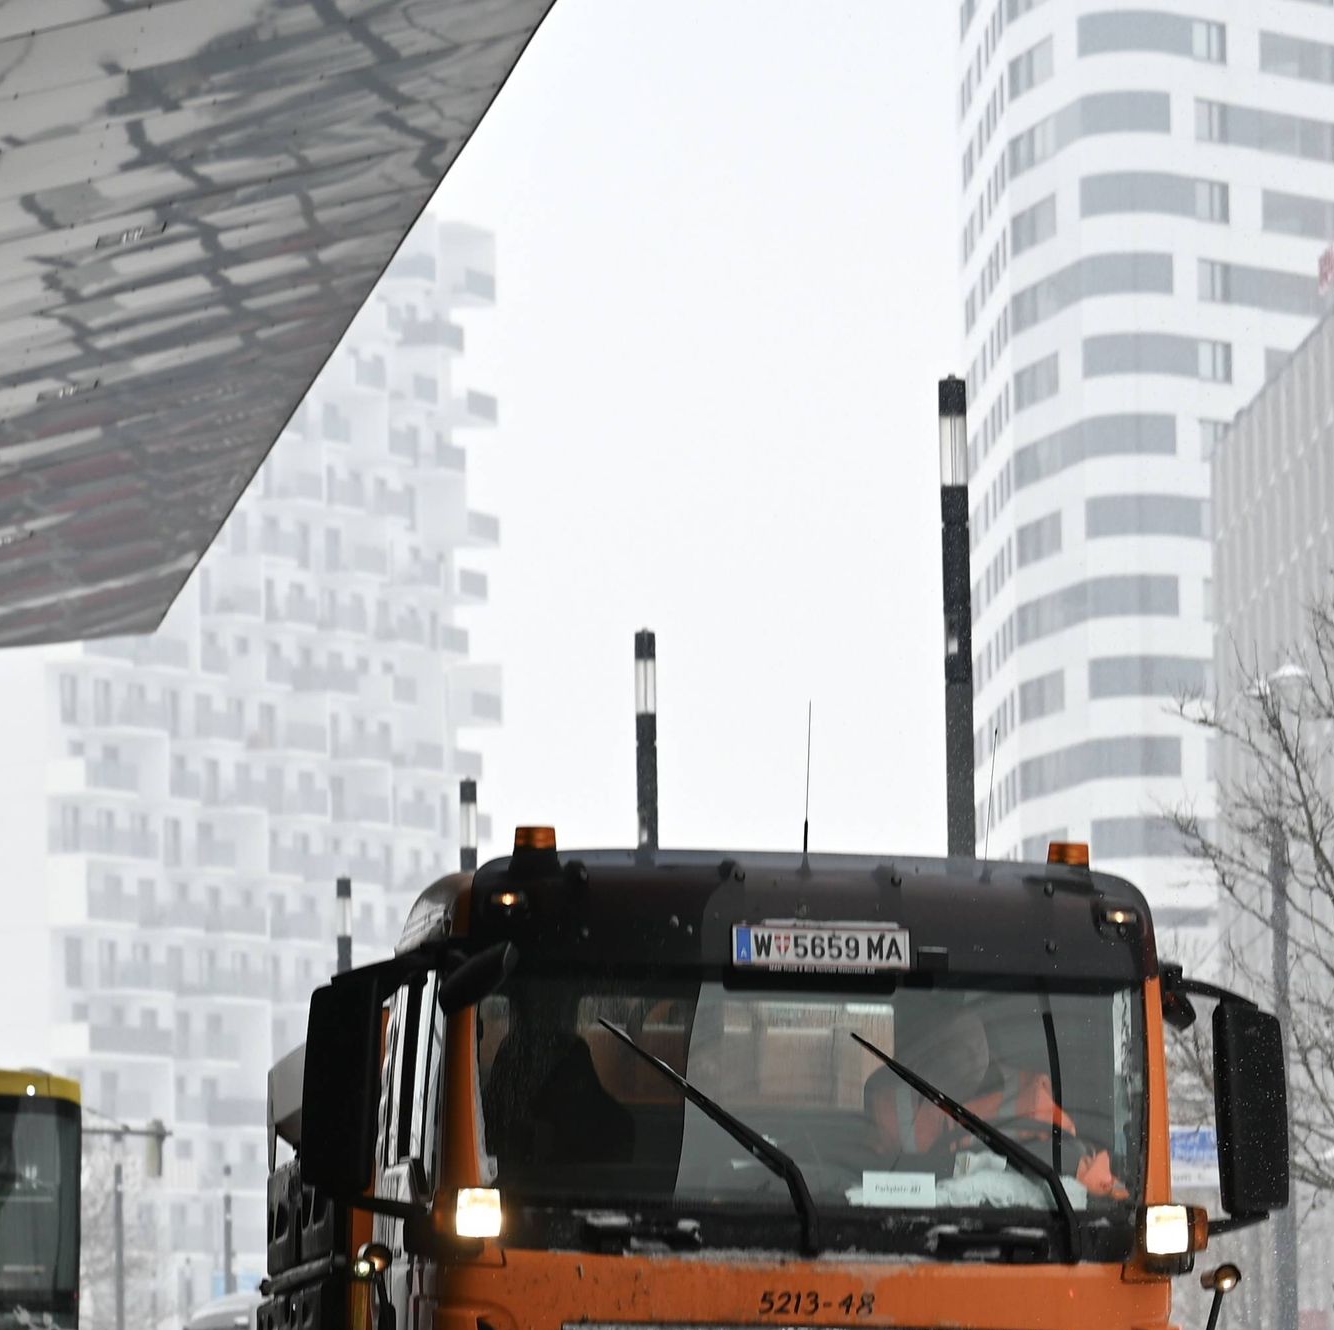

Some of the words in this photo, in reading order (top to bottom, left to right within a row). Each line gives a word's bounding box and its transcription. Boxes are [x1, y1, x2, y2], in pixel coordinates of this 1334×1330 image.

[754, 933, 773, 958] W
[793, 935, 860, 960] 5659
[867, 935, 903, 961] MA
